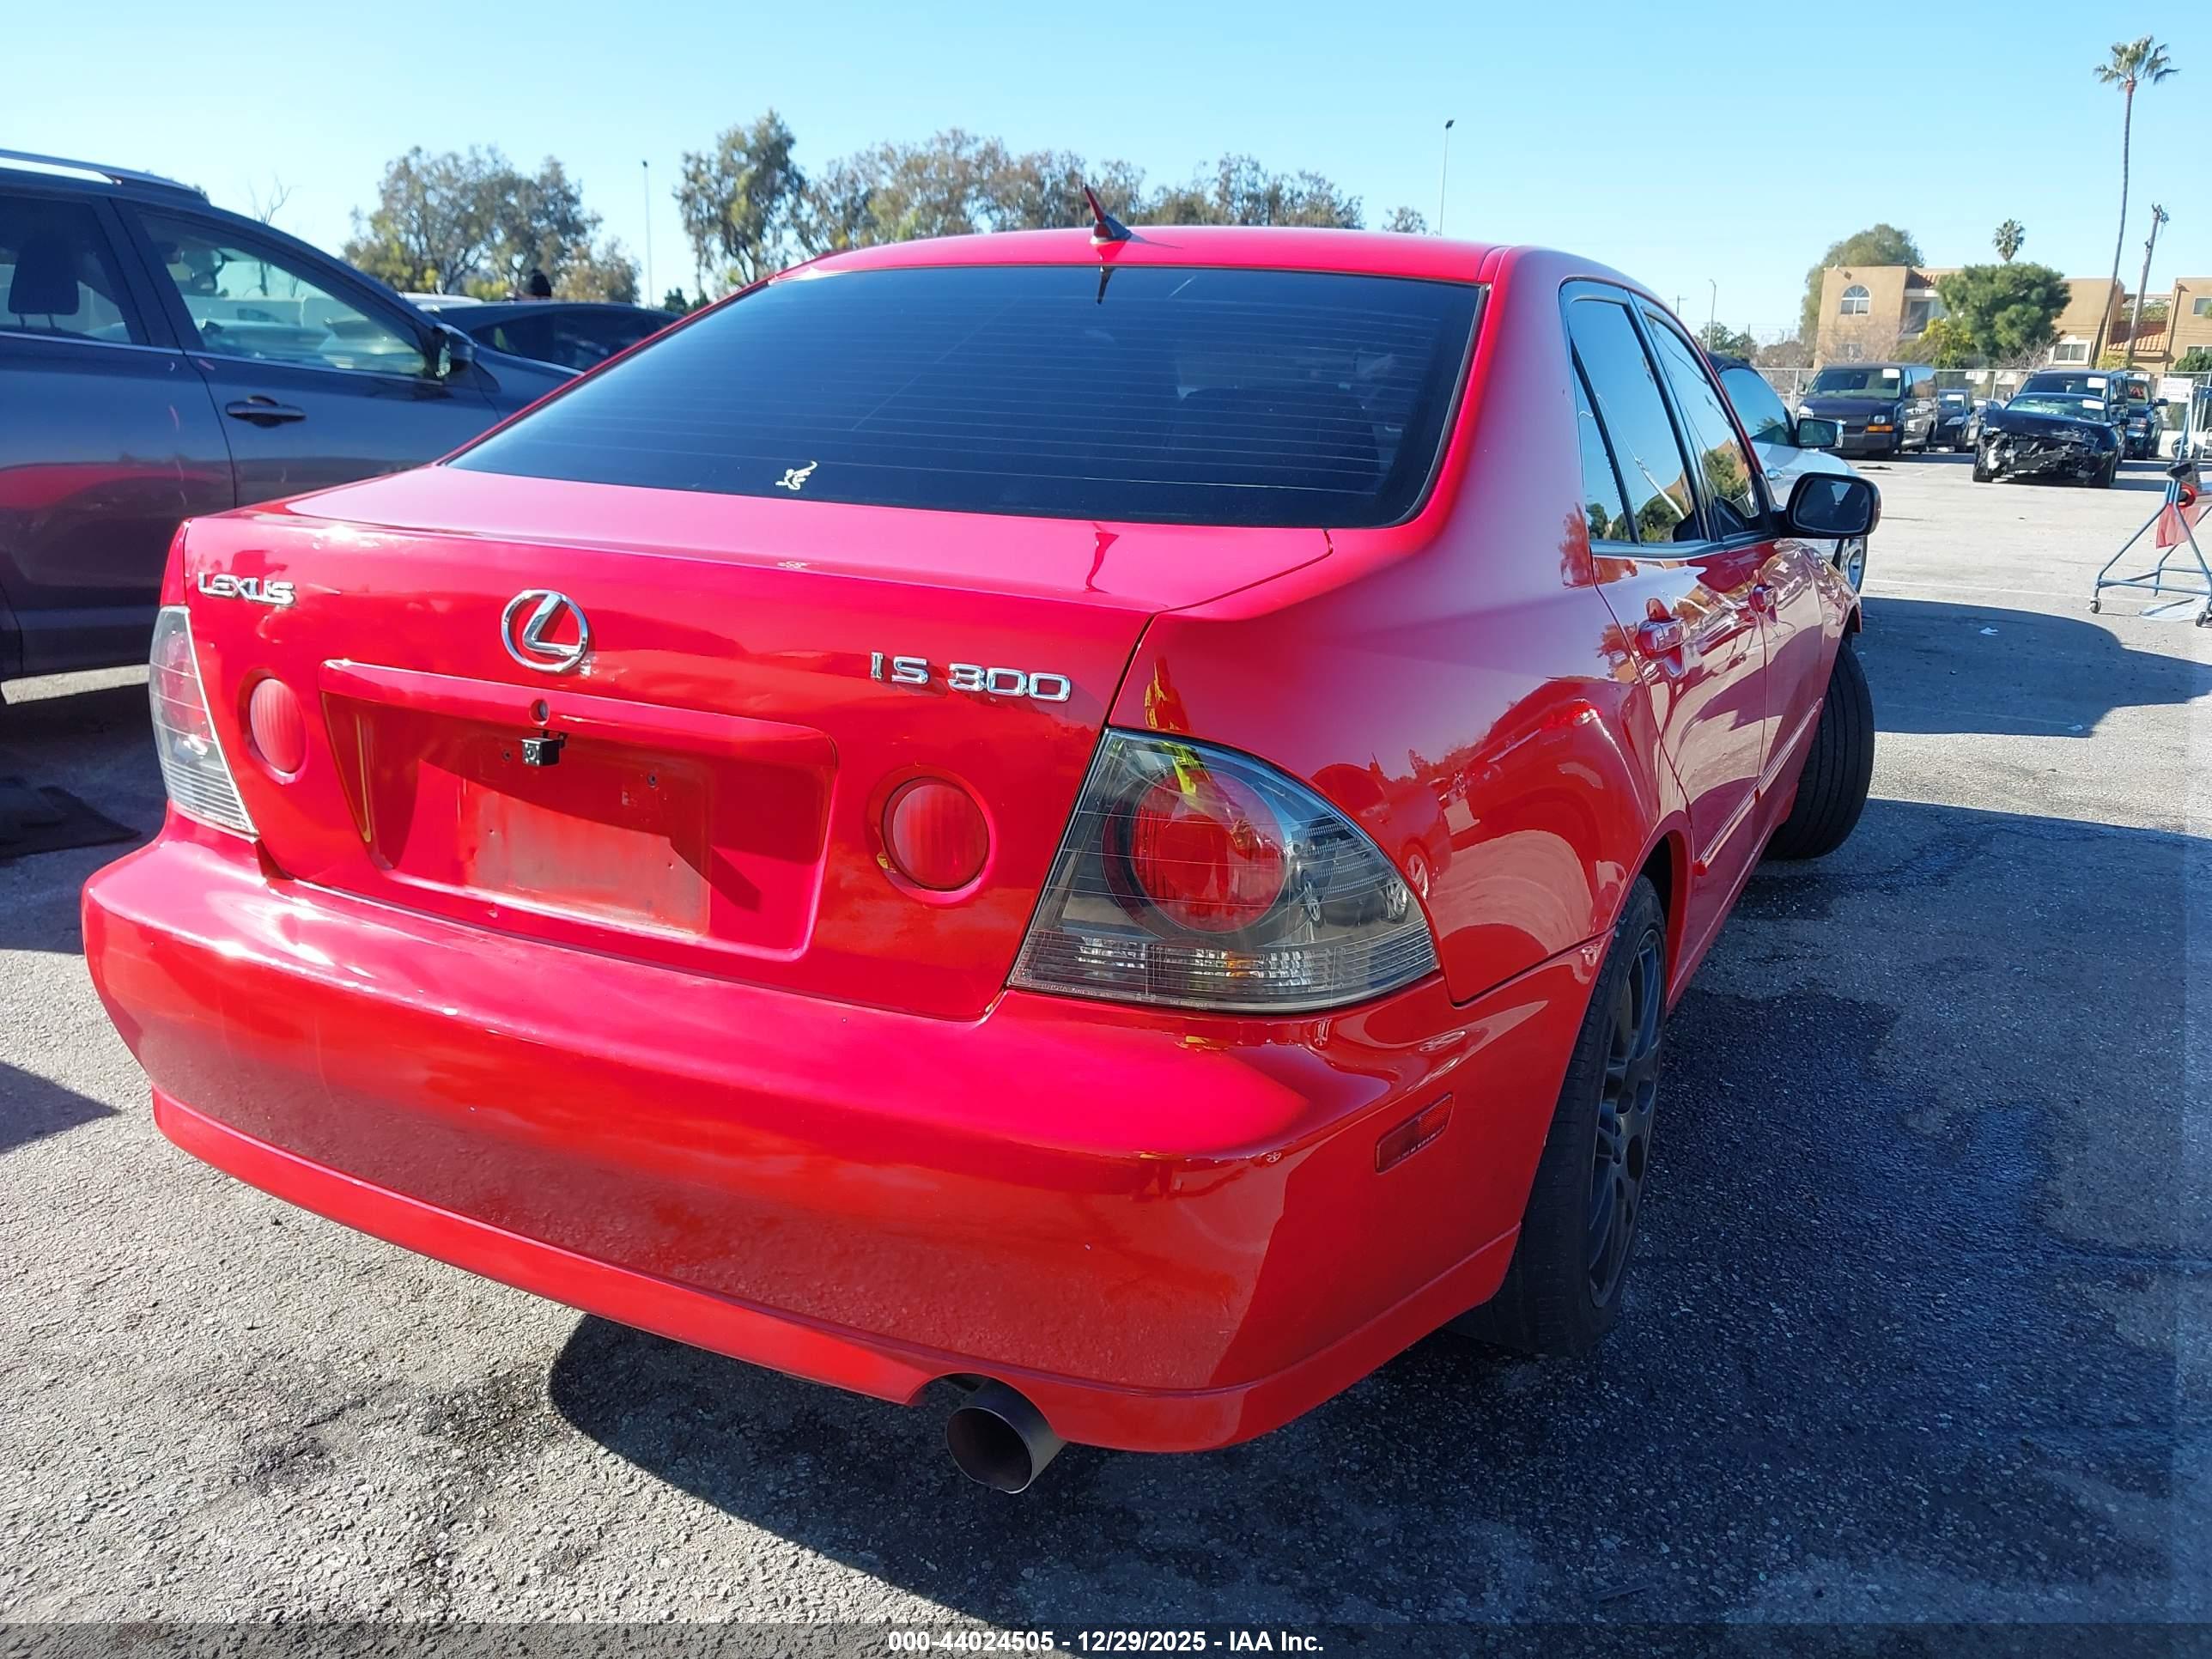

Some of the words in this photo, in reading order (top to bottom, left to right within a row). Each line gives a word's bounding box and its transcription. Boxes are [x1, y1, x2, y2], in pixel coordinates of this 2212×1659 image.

[198, 572, 295, 606] LEXUS
[870, 652, 929, 684] IS
[947, 662, 1071, 702] 300
